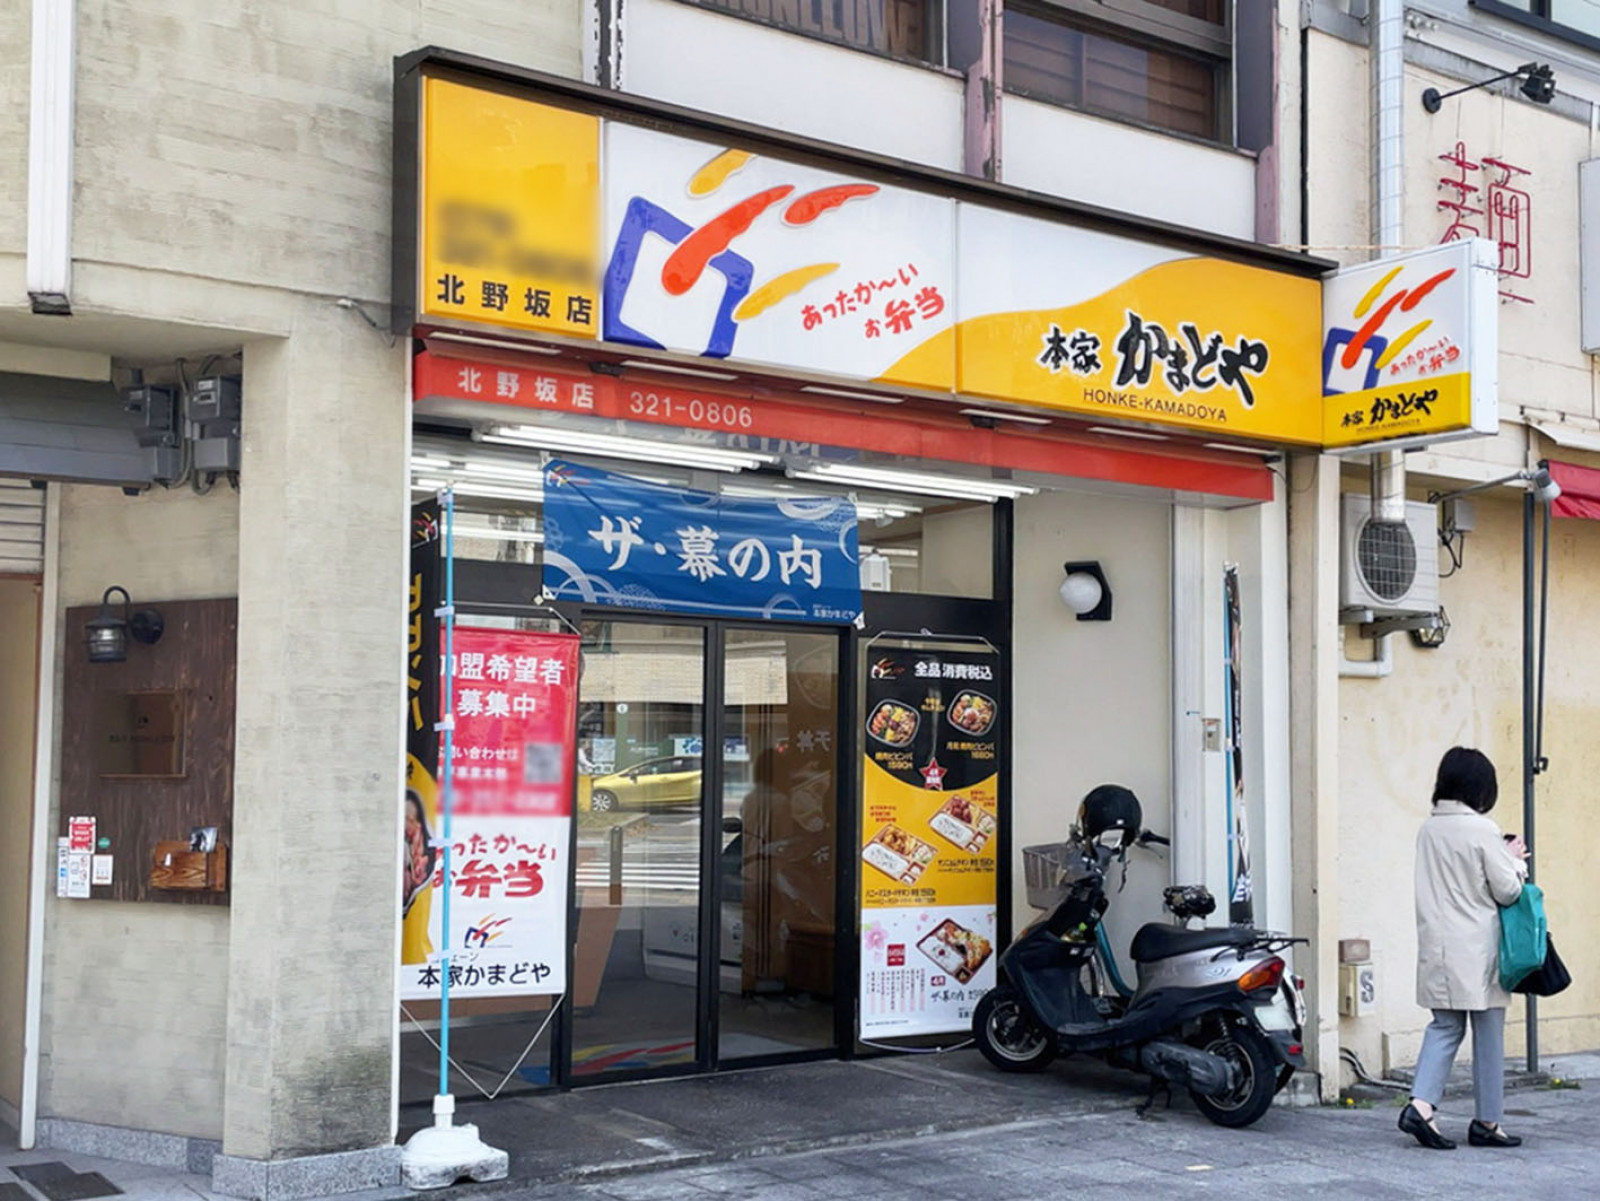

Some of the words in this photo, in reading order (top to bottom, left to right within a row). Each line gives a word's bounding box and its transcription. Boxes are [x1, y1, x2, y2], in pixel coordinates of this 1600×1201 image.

[437, 273, 592, 324] 北野坂店
[865, 286, 945, 339] お弁当
[1038, 326, 1100, 373] 本家
[1114, 312, 1268, 406] かまどや
[458, 368, 594, 408] 北野坂店
[629, 392, 753, 428] 321-0806
[1083, 388, 1228, 422] HONKE-KAMADOYA
[1370, 388, 1438, 424] かまどや
[457, 688, 536, 719] 募集中
[418, 963, 551, 989] 本家かまどや
